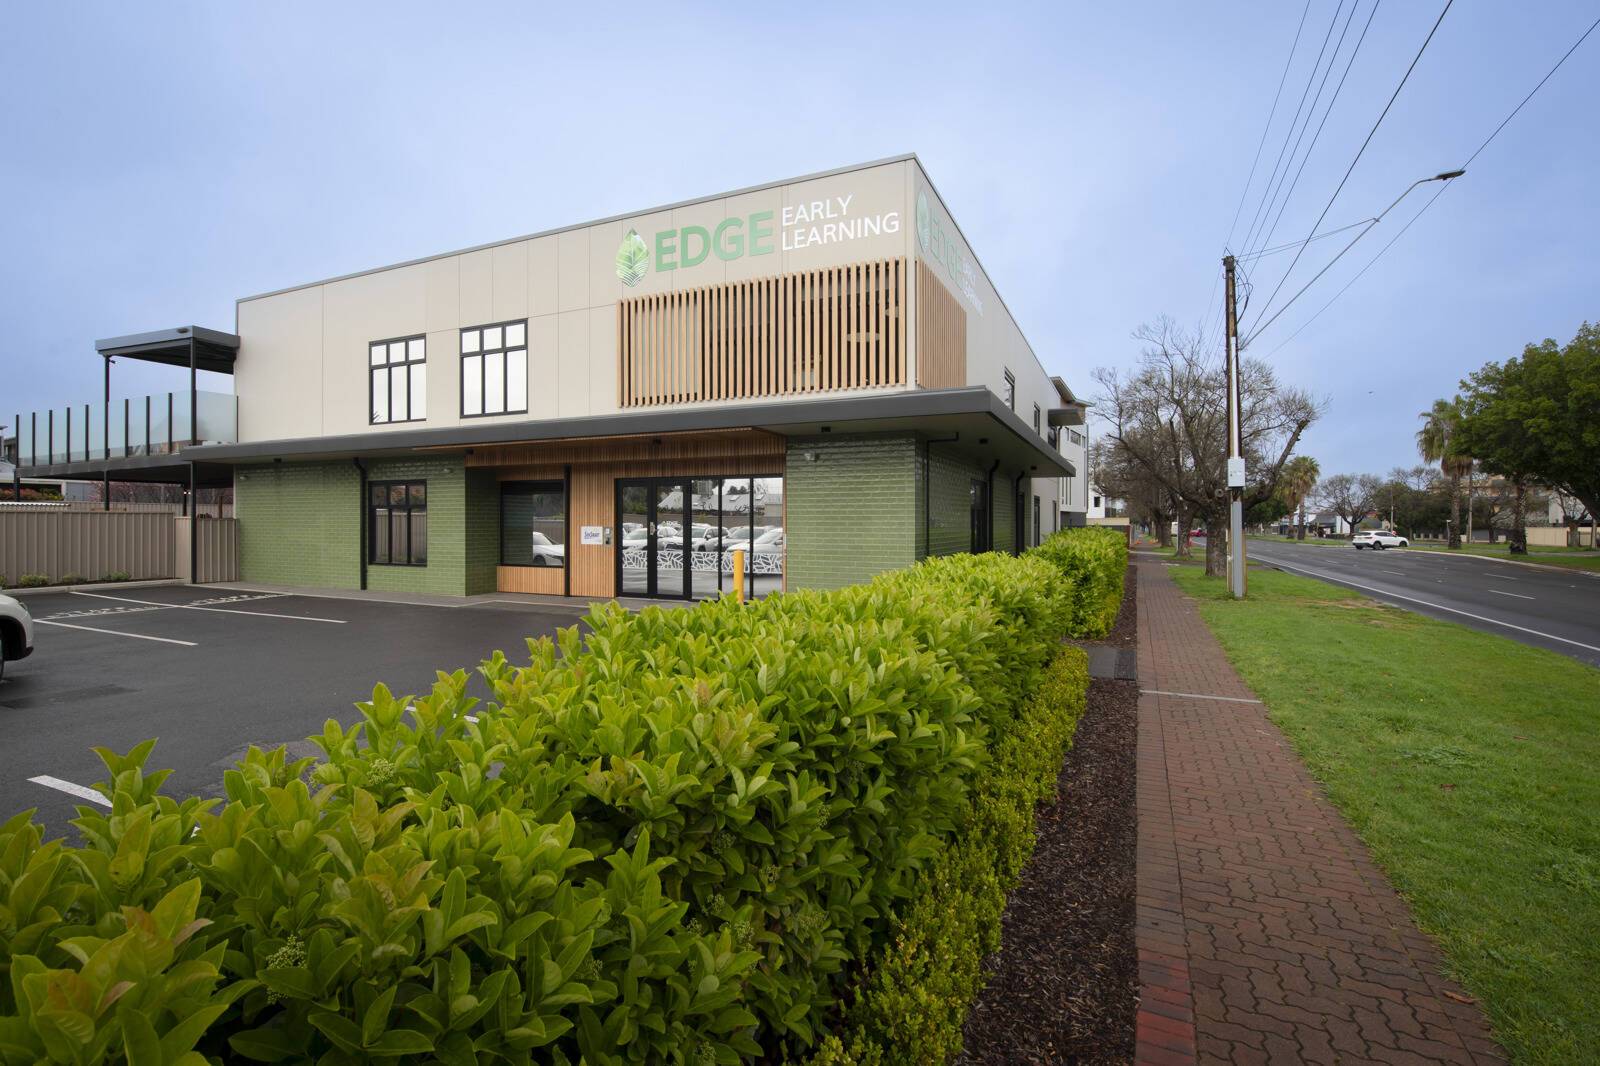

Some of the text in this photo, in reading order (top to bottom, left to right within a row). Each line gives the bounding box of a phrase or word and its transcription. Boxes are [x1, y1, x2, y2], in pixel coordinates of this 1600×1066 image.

[782, 194, 854, 227] EARLY
[655, 210, 775, 273] EDGE
[782, 212, 900, 251] LEARNING
